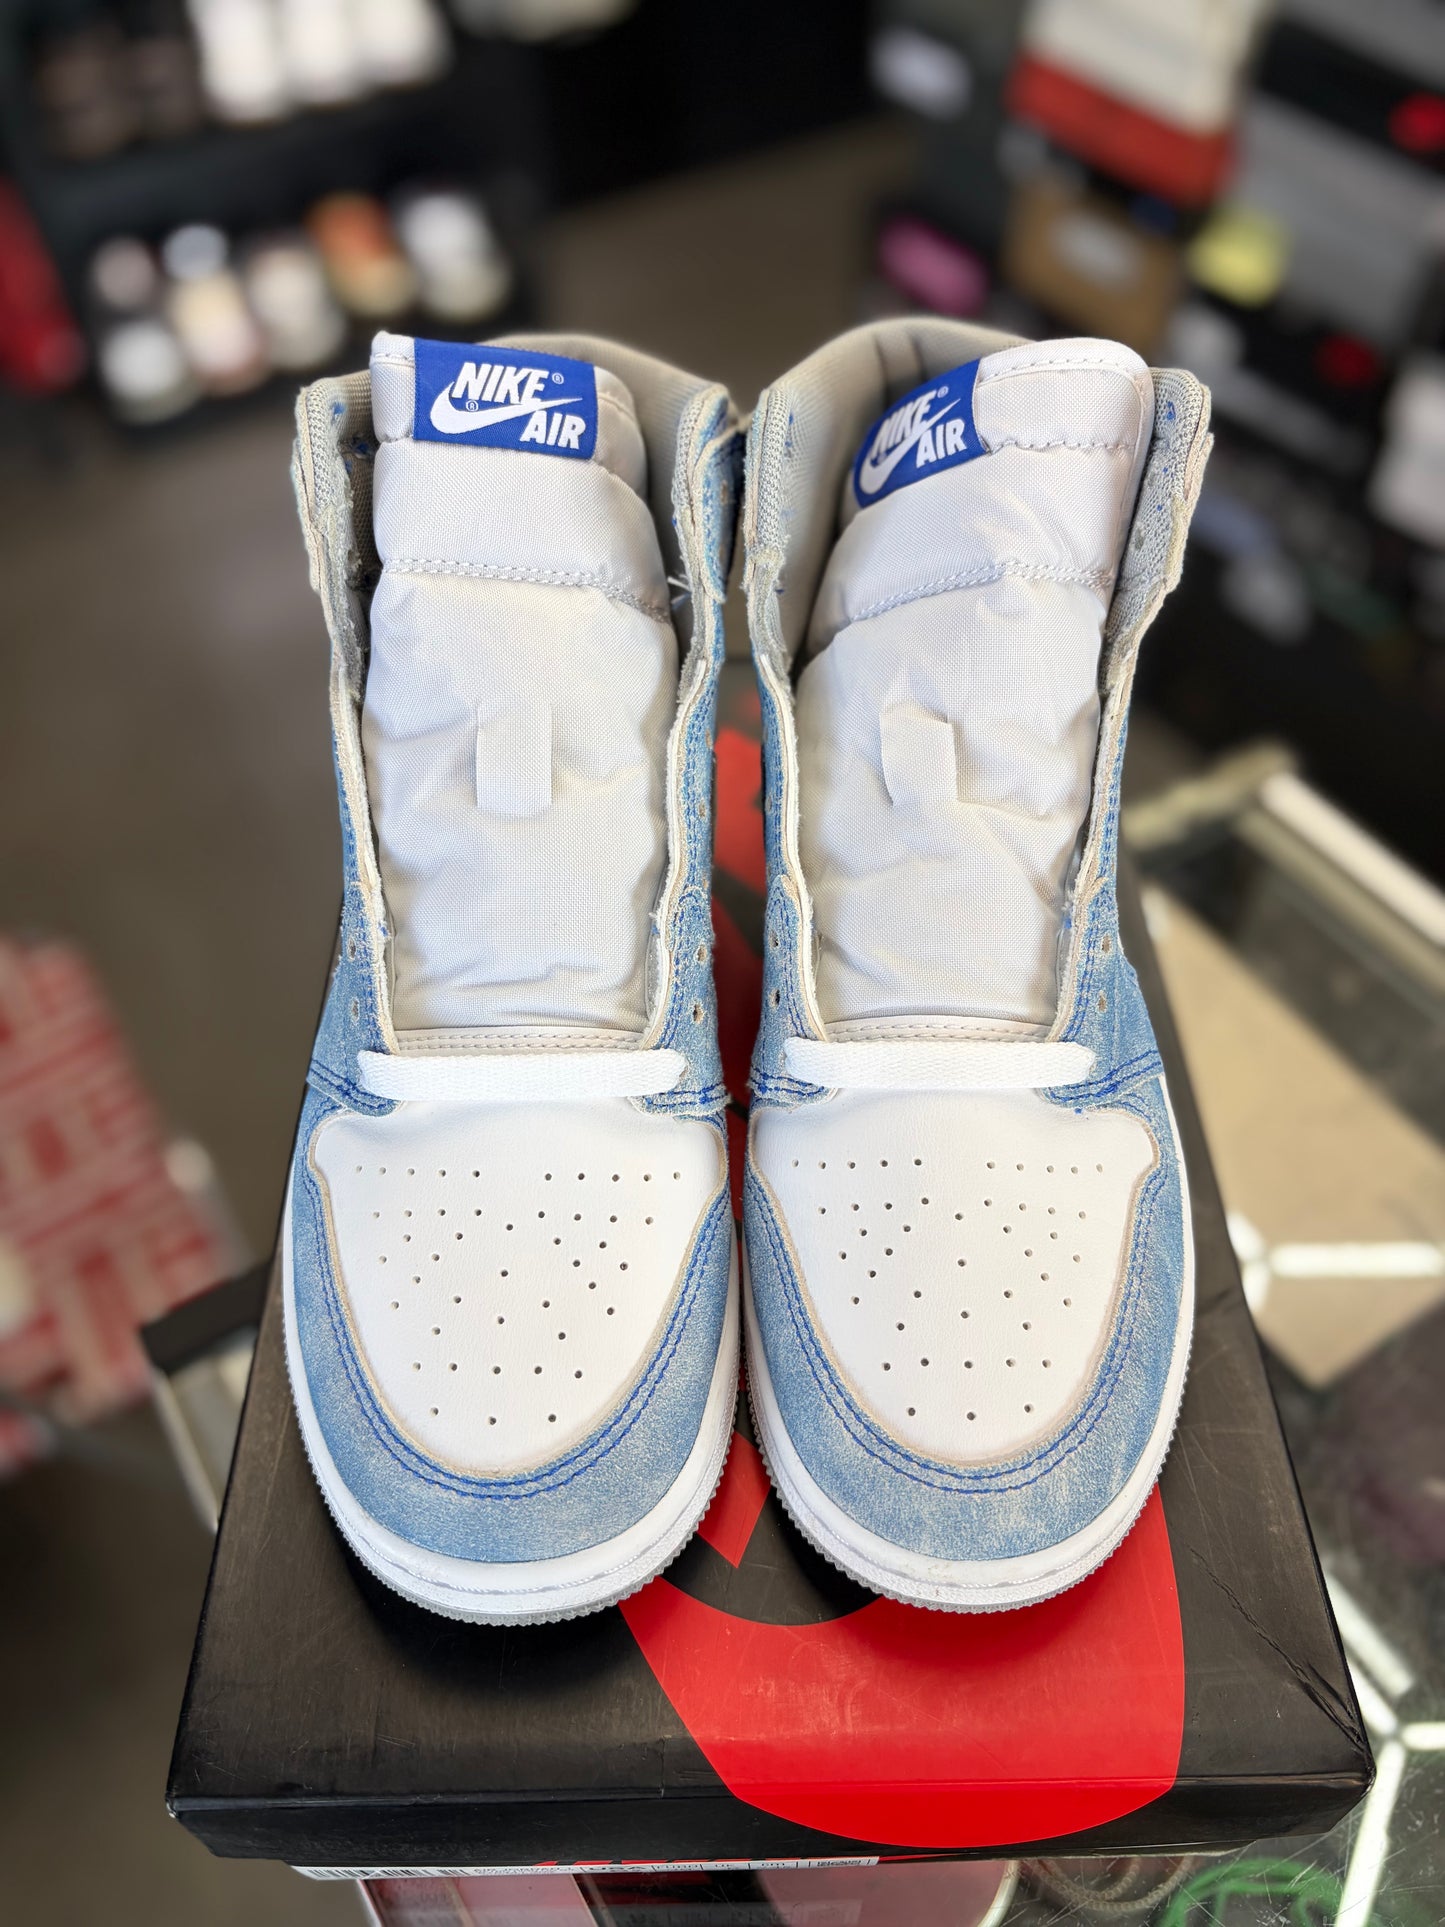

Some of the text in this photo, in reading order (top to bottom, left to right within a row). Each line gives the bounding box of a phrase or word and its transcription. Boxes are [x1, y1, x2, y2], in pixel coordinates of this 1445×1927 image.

[452, 362, 549, 405] NIKE
[519, 410, 586, 449] AIR
[870, 389, 937, 461] NIKE
[916, 418, 967, 468] AIR
